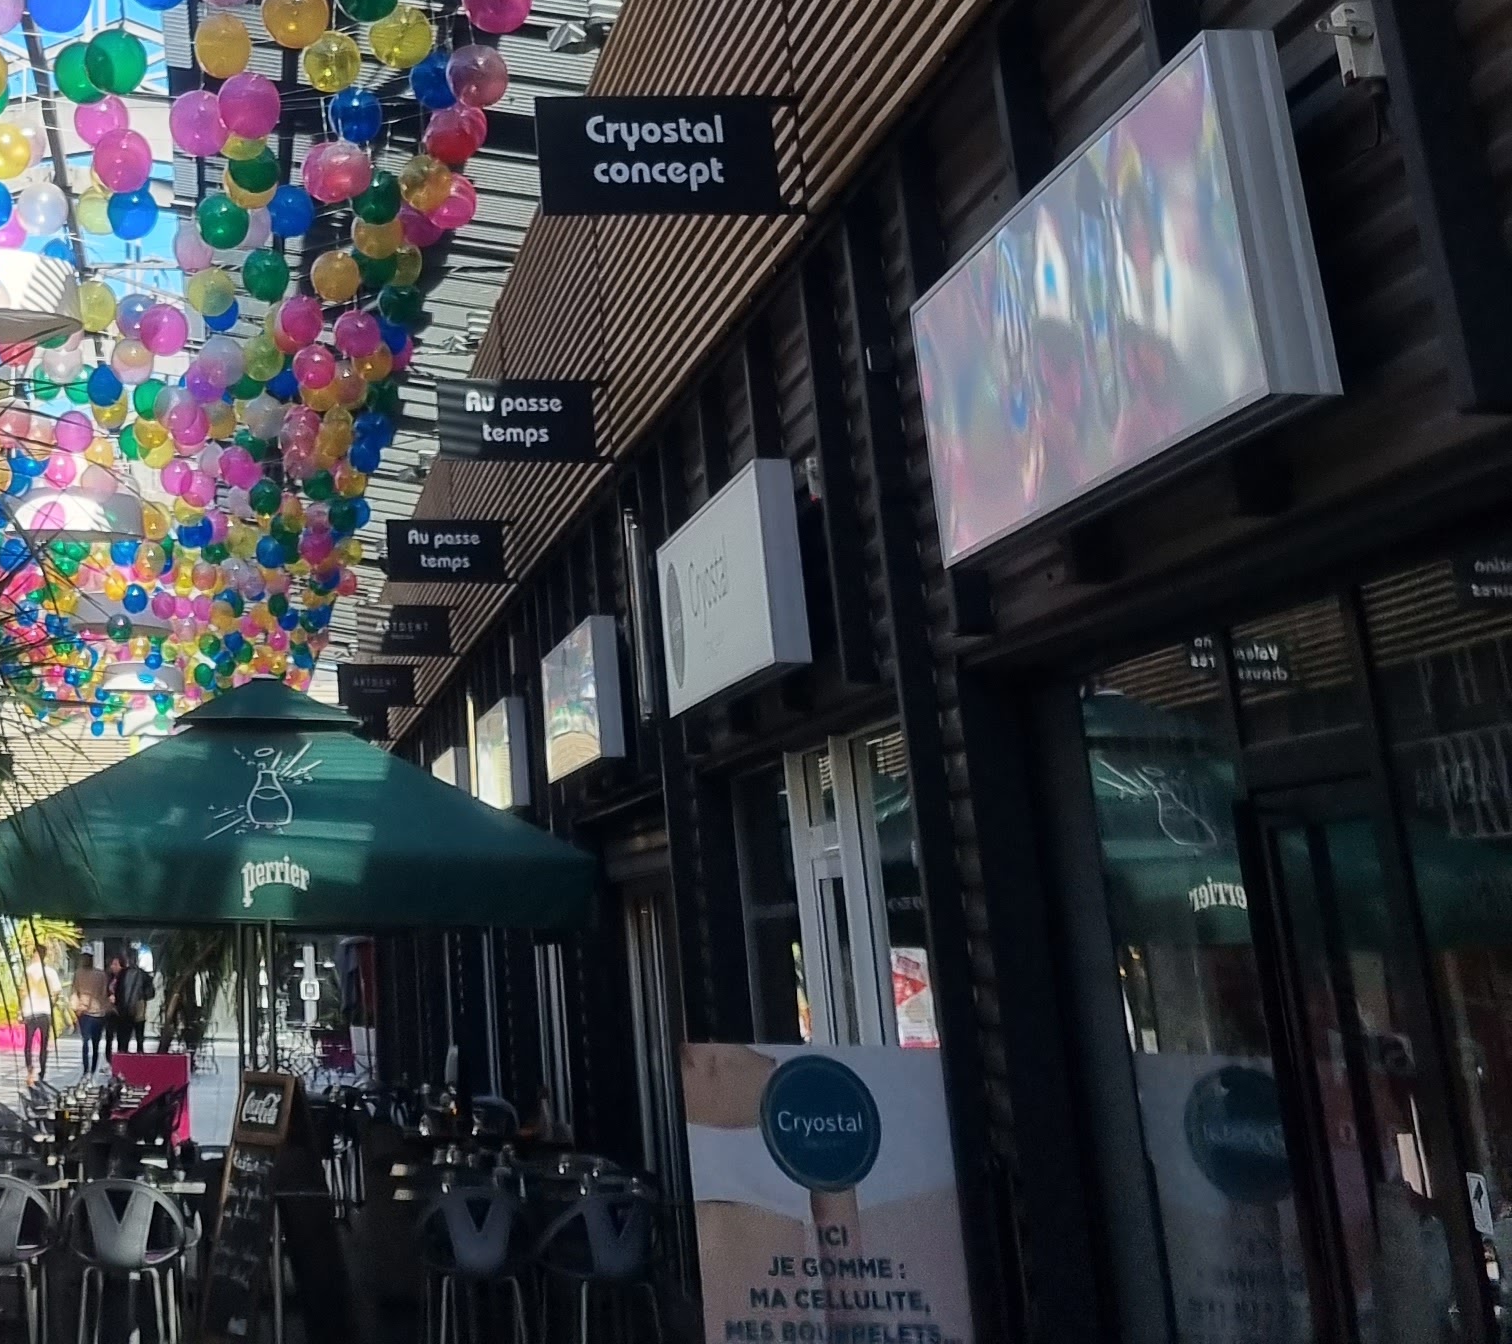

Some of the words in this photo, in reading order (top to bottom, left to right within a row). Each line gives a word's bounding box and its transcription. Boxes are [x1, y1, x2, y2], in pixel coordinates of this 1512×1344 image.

[585, 114, 724, 152] Cryostal
[593, 157, 725, 192] concept
[465, 391, 495, 412] Au
[500, 396, 563, 417] passe
[482, 422, 550, 448] temps
[407, 528, 429, 545] Au
[433, 533, 481, 549] passe
[420, 554, 471, 573] temps
[777, 1110, 863, 1137] Cryostal
[817, 1225, 849, 1247] ICI
[768, 1255, 795, 1278] JE
[801, 1257, 893, 1279] GOMME
[749, 1287, 787, 1309] MA
[794, 1288, 931, 1316] CELLULITE,
[724, 1319, 774, 1343] MES
